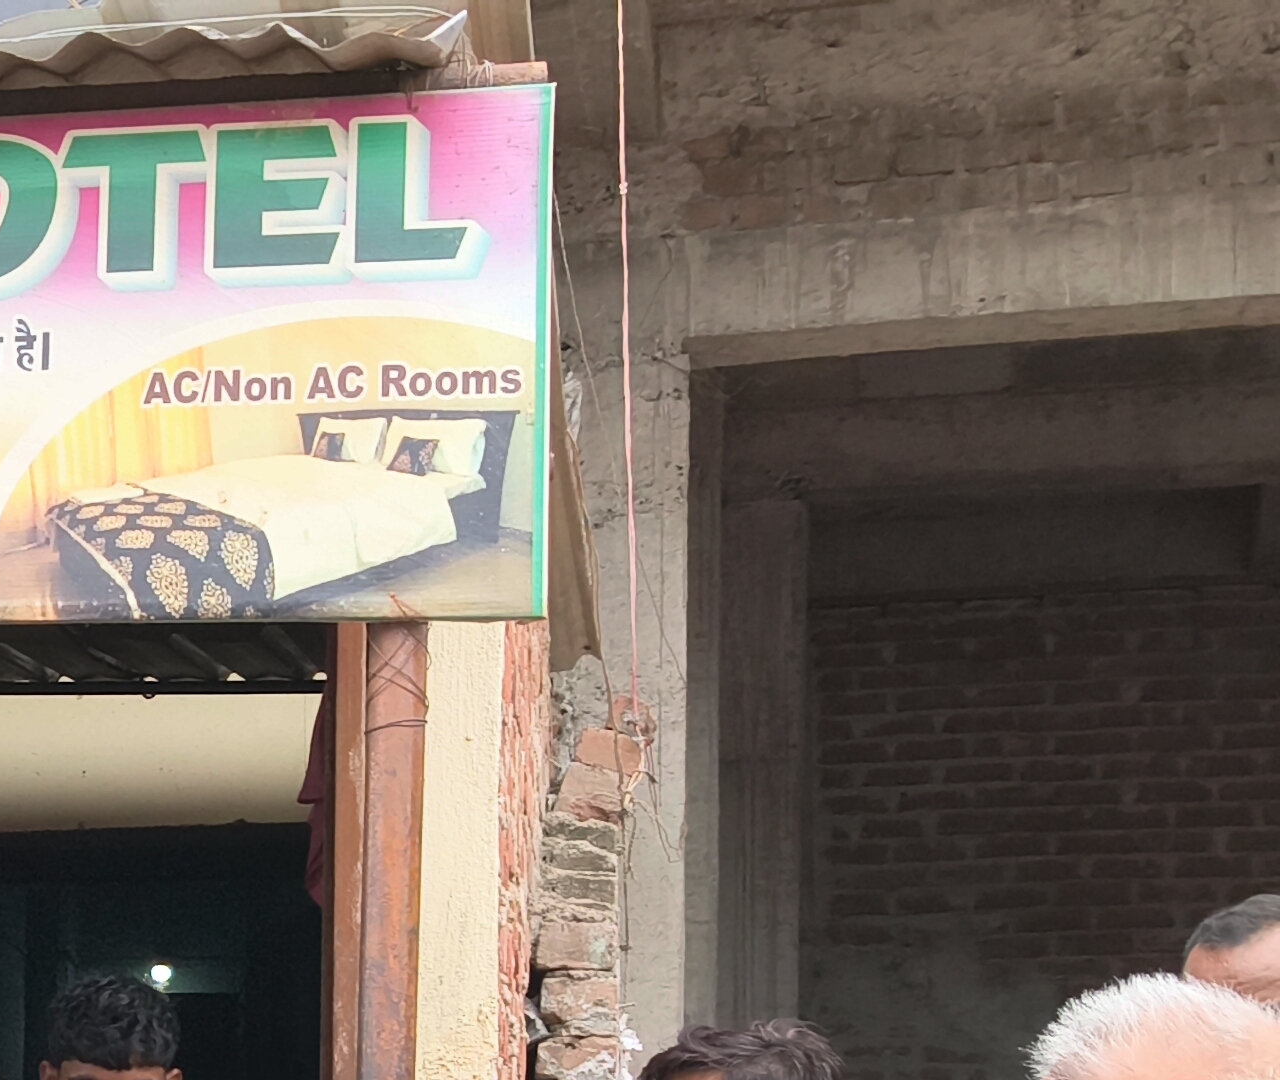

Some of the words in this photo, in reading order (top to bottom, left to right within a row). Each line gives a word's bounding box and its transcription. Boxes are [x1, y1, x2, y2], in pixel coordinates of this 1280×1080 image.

[15, 318, 50, 371] है।
[143, 368, 292, 405] AC/Non
[306, 365, 365, 400] AC
[381, 363, 523, 398] Rooms
